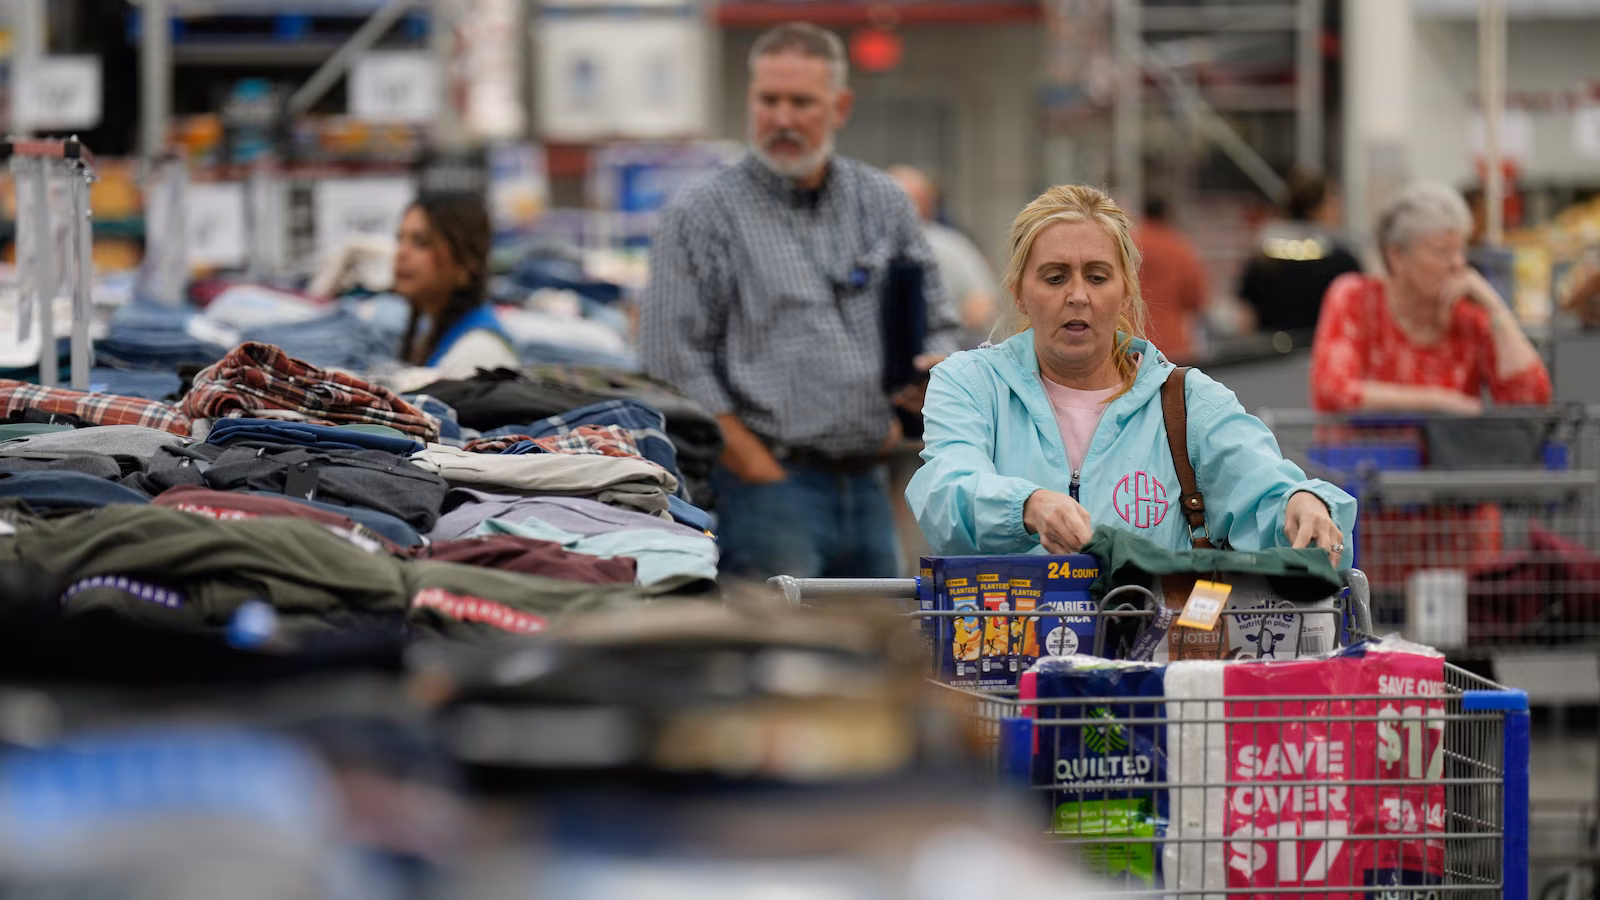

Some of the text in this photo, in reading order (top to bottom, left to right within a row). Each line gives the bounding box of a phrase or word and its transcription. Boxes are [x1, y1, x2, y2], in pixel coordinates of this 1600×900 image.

[1047, 562, 1099, 579] 24 COUNT
[949, 586, 979, 596] PLANTERS
[980, 582, 1010, 591] PLANTERS
[1011, 588, 1041, 597] PLANTERS
[1378, 674, 1445, 697] SAVE OVE
[1377, 702, 1445, 779] $17
[1055, 755, 1151, 780] QUILTED
[1236, 741, 1345, 777] SAVE
[1232, 780, 1348, 815] OVER
[1229, 820, 1348, 883] $17
